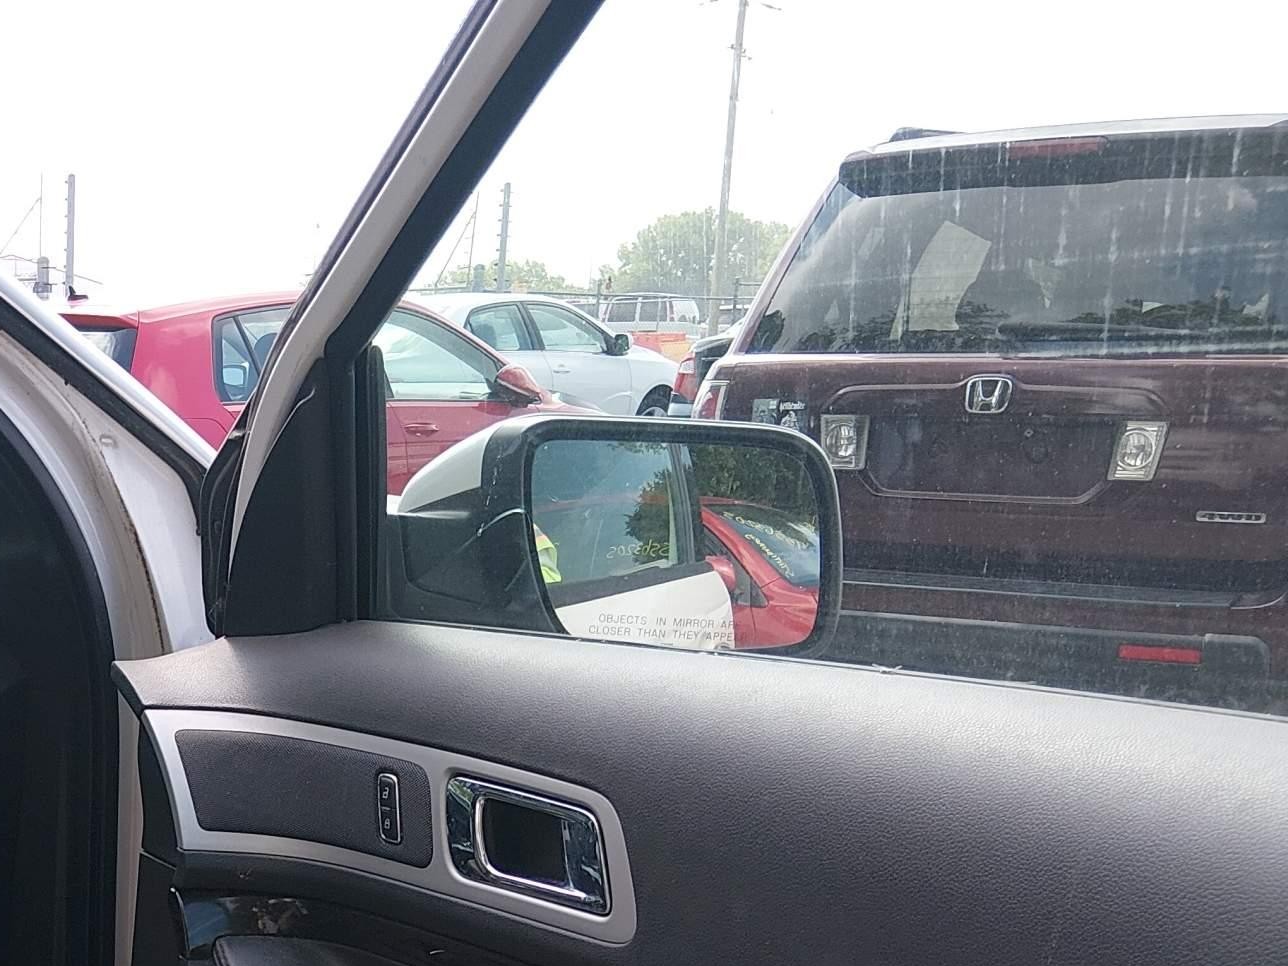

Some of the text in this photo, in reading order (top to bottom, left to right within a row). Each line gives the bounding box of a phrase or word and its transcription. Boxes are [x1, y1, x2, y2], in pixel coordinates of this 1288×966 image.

[598, 612, 648, 626] OBJECTS
[655, 617, 667, 626] IN
[672, 618, 714, 629] MIRROR
[588, 624, 631, 636] CLOSER
[637, 627, 666, 638] THAN
[672, 629, 699, 641] THEY
